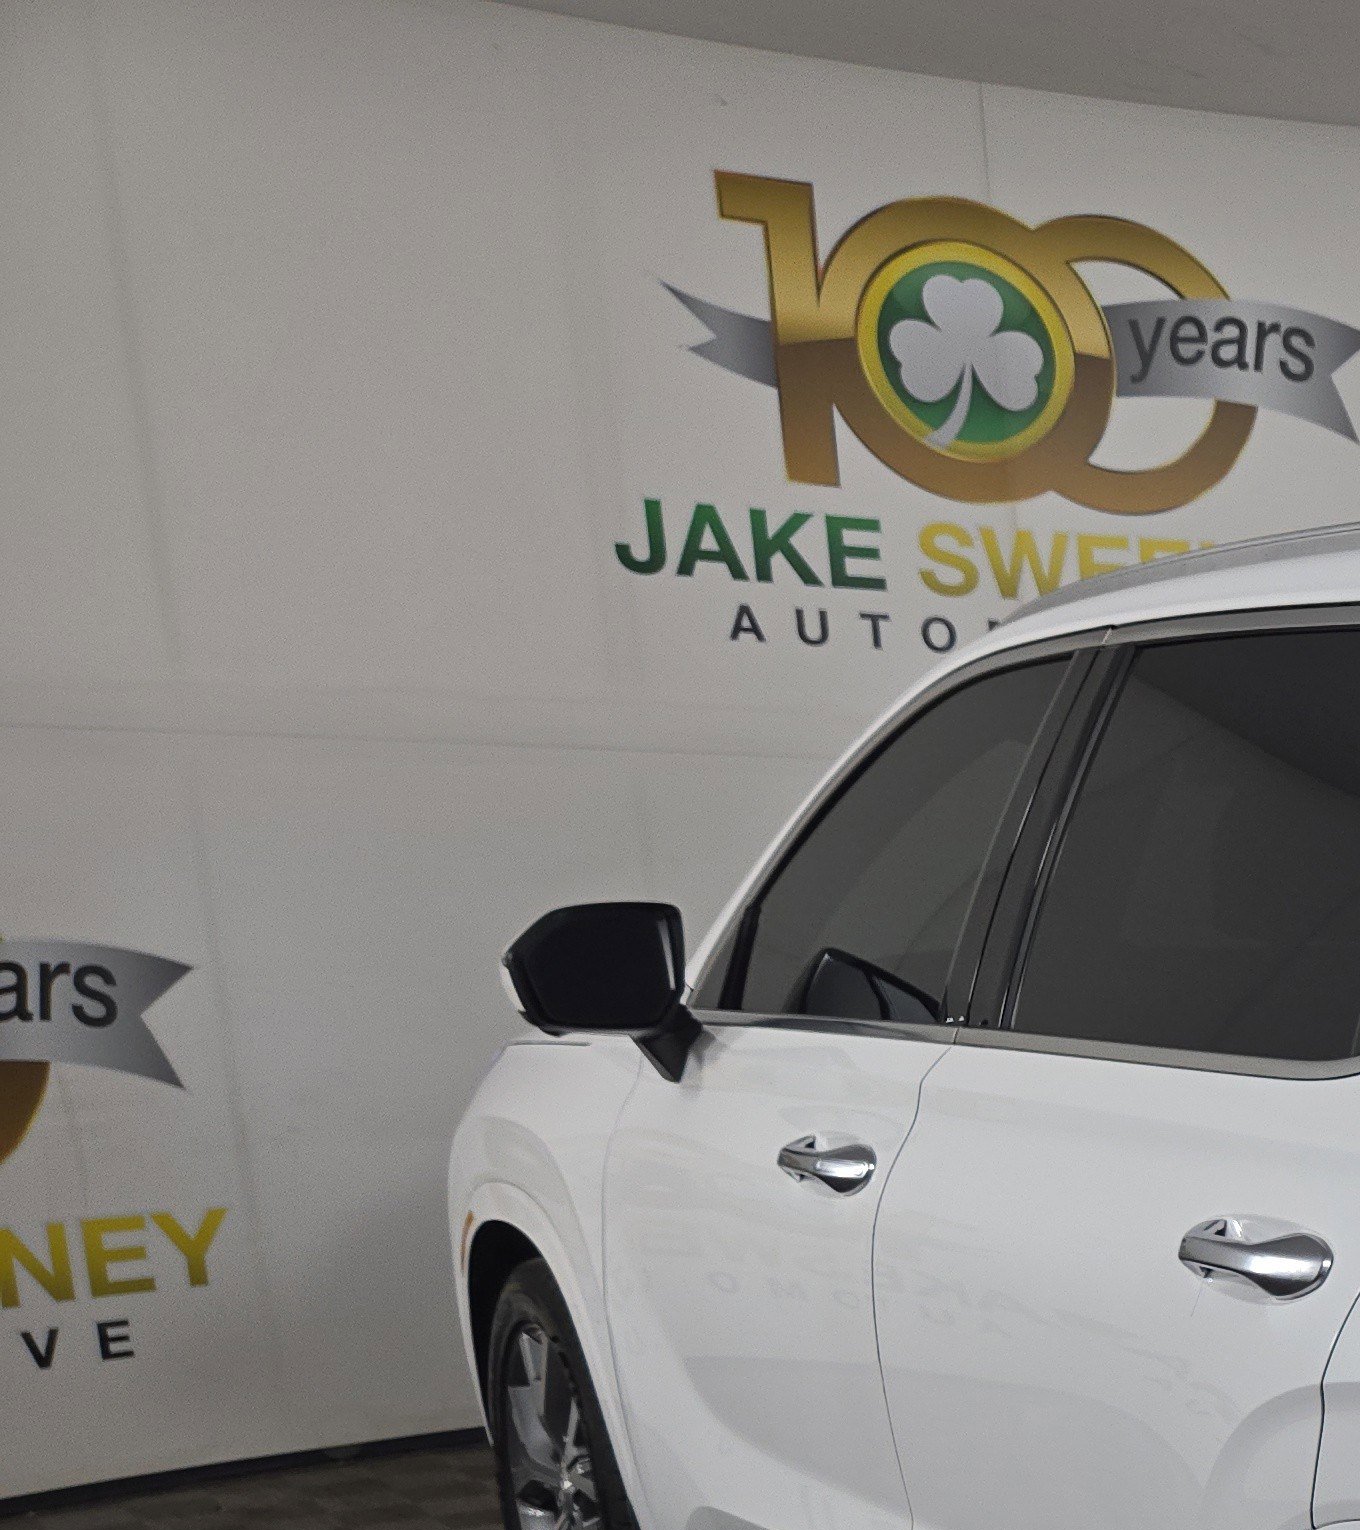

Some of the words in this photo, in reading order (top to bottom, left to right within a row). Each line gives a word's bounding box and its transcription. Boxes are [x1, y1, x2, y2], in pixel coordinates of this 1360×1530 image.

[1127, 311, 1317, 385] years
[614, 498, 888, 592] JAKE
[729, 603, 1001, 653] AUTO
